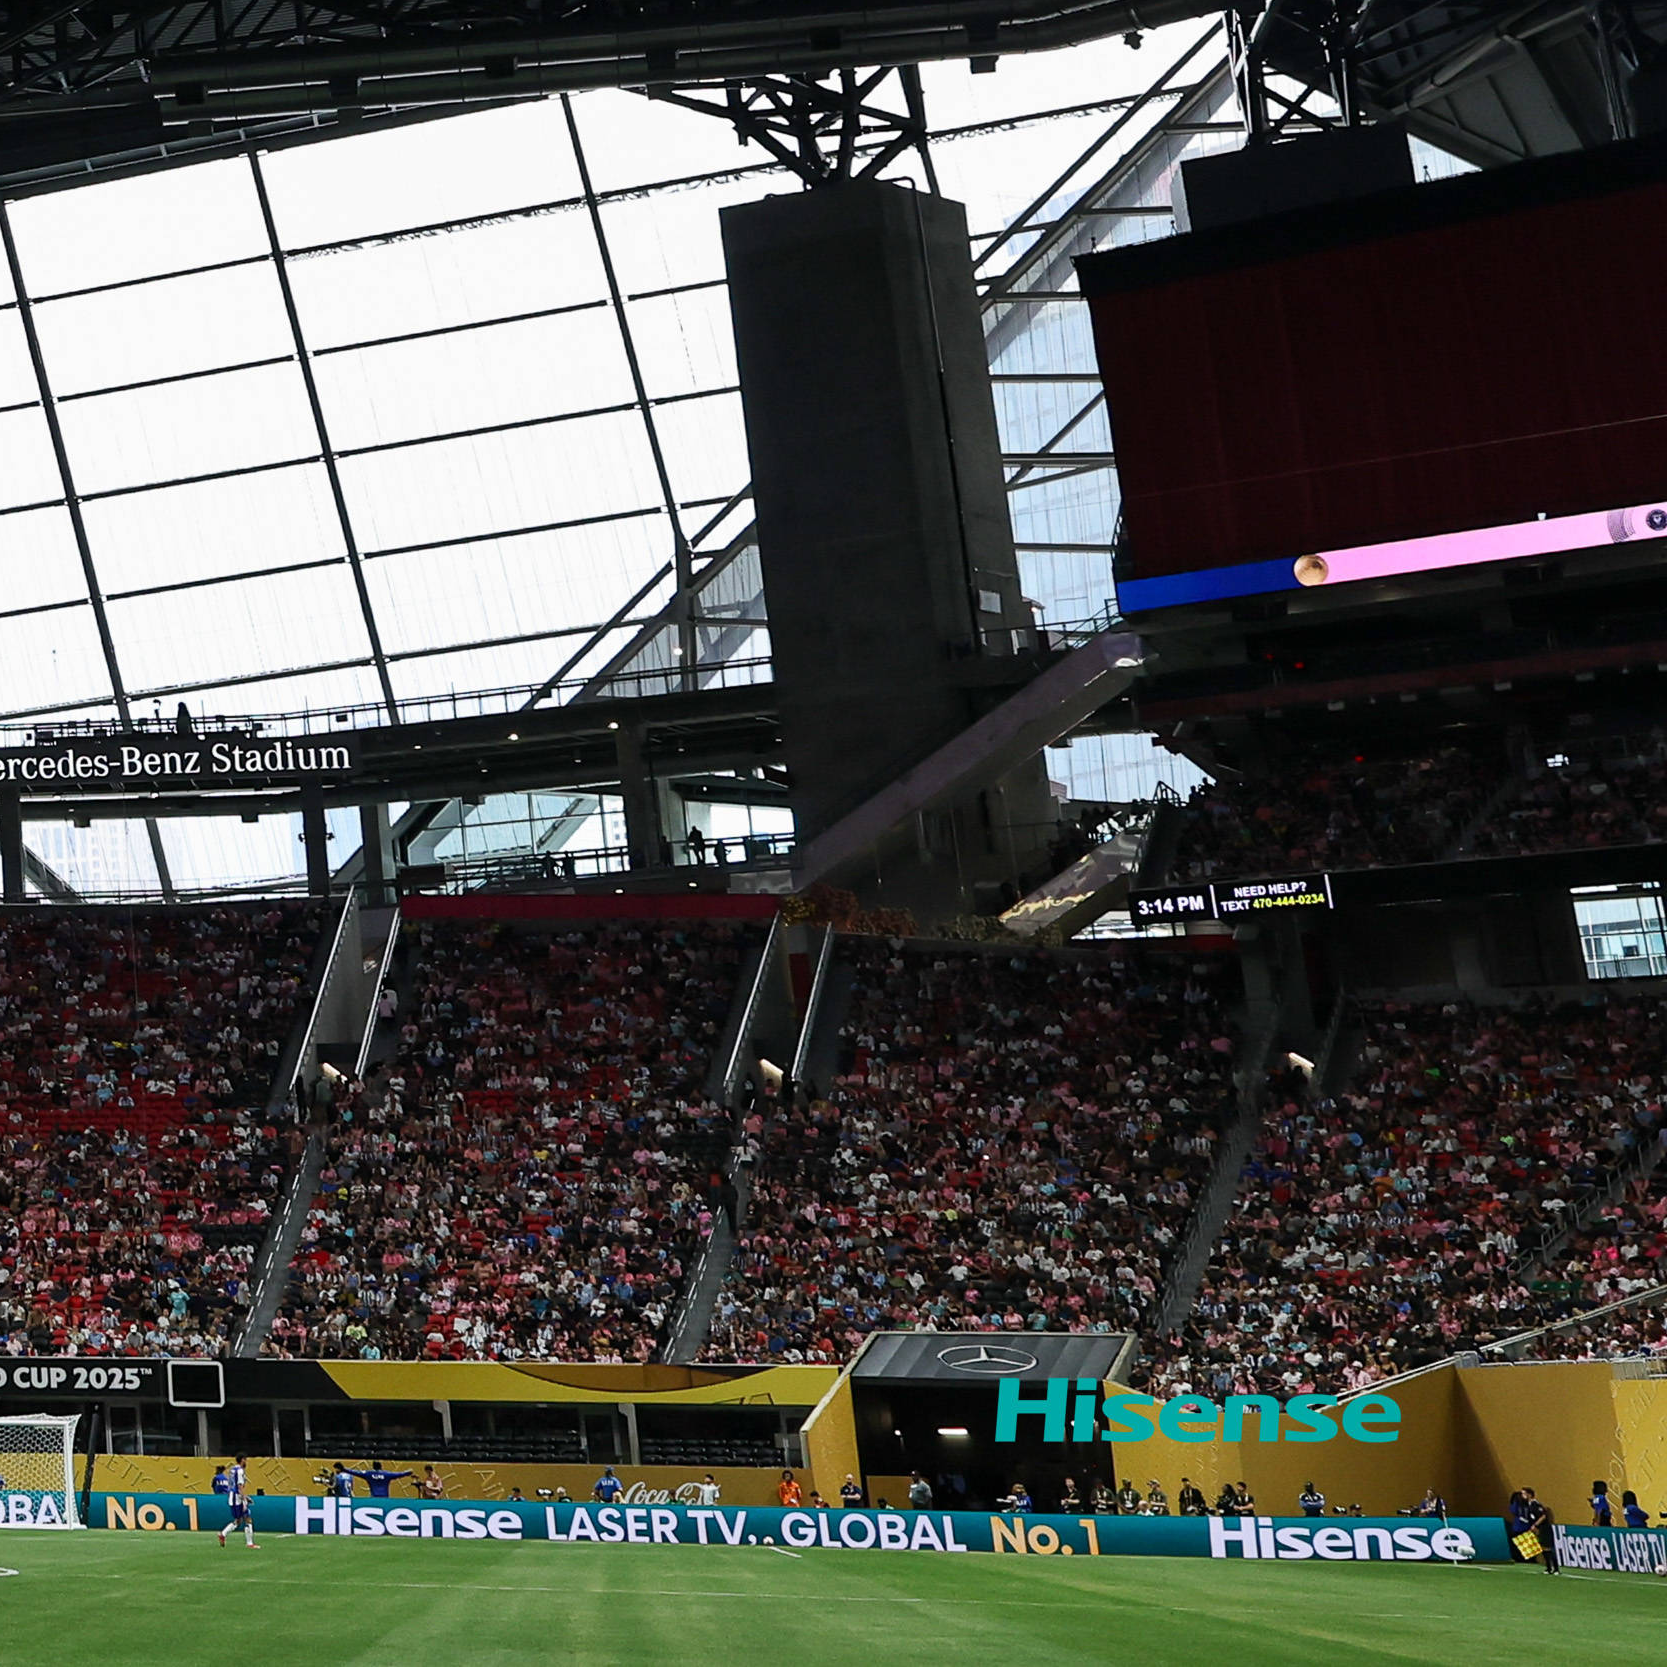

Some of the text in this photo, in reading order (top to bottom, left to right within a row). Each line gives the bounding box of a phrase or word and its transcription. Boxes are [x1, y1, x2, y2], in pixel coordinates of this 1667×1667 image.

[211, 741, 352, 774] Stadium
[1220, 893, 1326, 912] TEXT 470-444-0234
[1233, 881, 1307, 898] NEED HELP?
[1138, 895, 1204, 915] 3:14 PM
[13, 1367, 67, 1390] CUP
[295, 1496, 523, 1541] Hisense
[545, 1506, 681, 1545] LASER
[686, 1509, 757, 1547] TV,
[780, 1511, 968, 1553] GLOBAL
[1207, 1517, 1474, 1561] Hisense
[1551, 1524, 1613, 1570] Hisense
[1611, 1532, 1654, 1574] LASER
